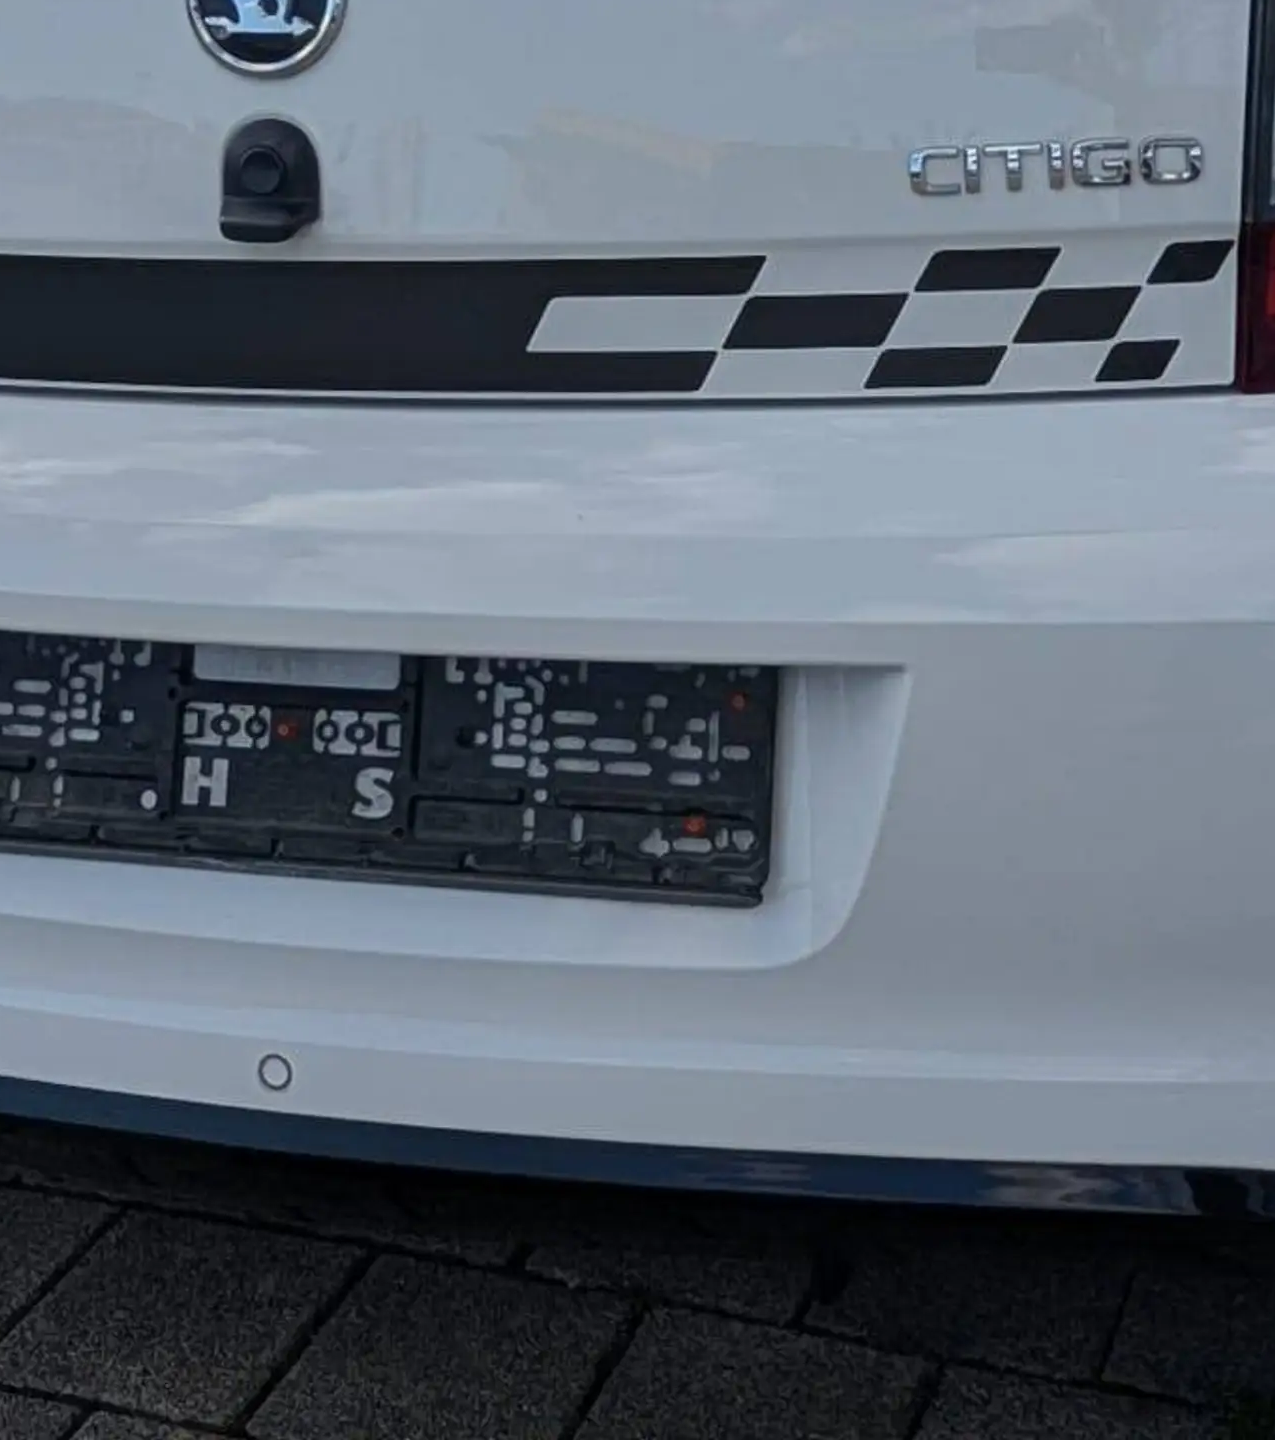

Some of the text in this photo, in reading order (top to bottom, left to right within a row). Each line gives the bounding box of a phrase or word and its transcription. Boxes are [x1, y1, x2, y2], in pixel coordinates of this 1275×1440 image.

[907, 136, 1205, 196] CITIGO
[181, 755, 395, 820] H S
